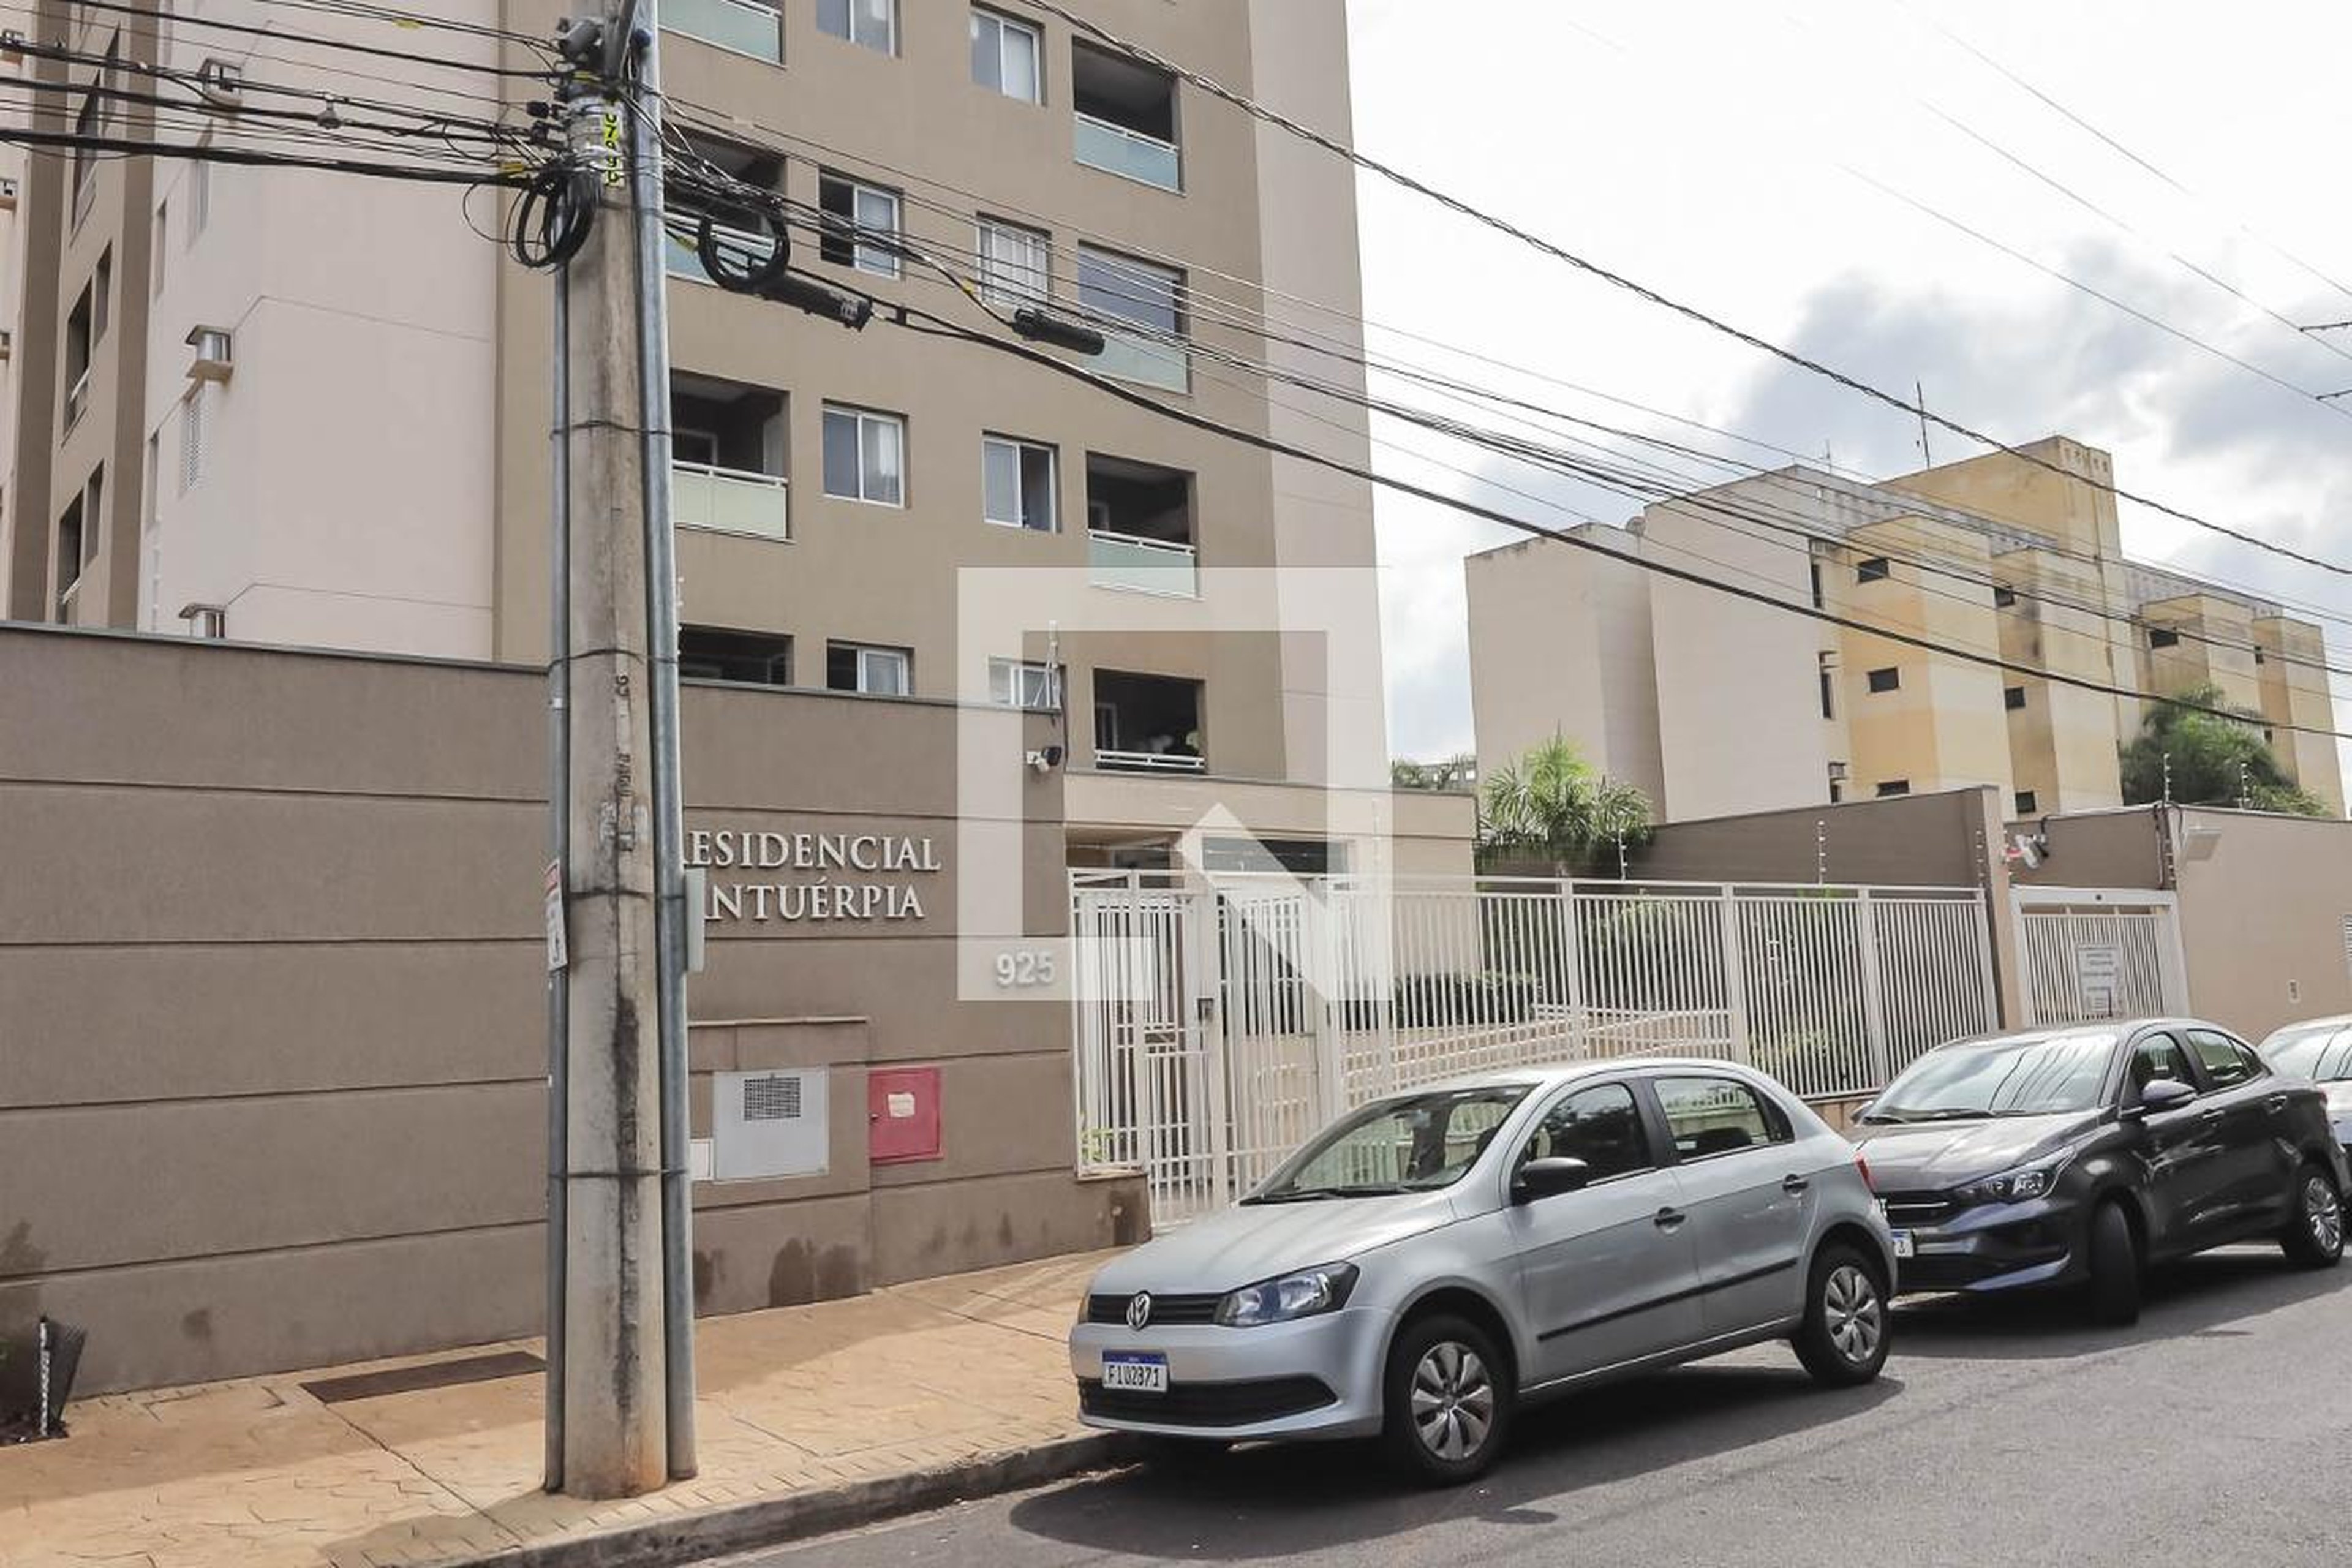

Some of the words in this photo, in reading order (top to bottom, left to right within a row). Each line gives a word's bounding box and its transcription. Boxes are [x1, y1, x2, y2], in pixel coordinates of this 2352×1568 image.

[683, 831, 942, 871] ESIDENCIAL
[705, 876, 926, 919] NTUÉRPIA
[996, 951, 1055, 986] 925
